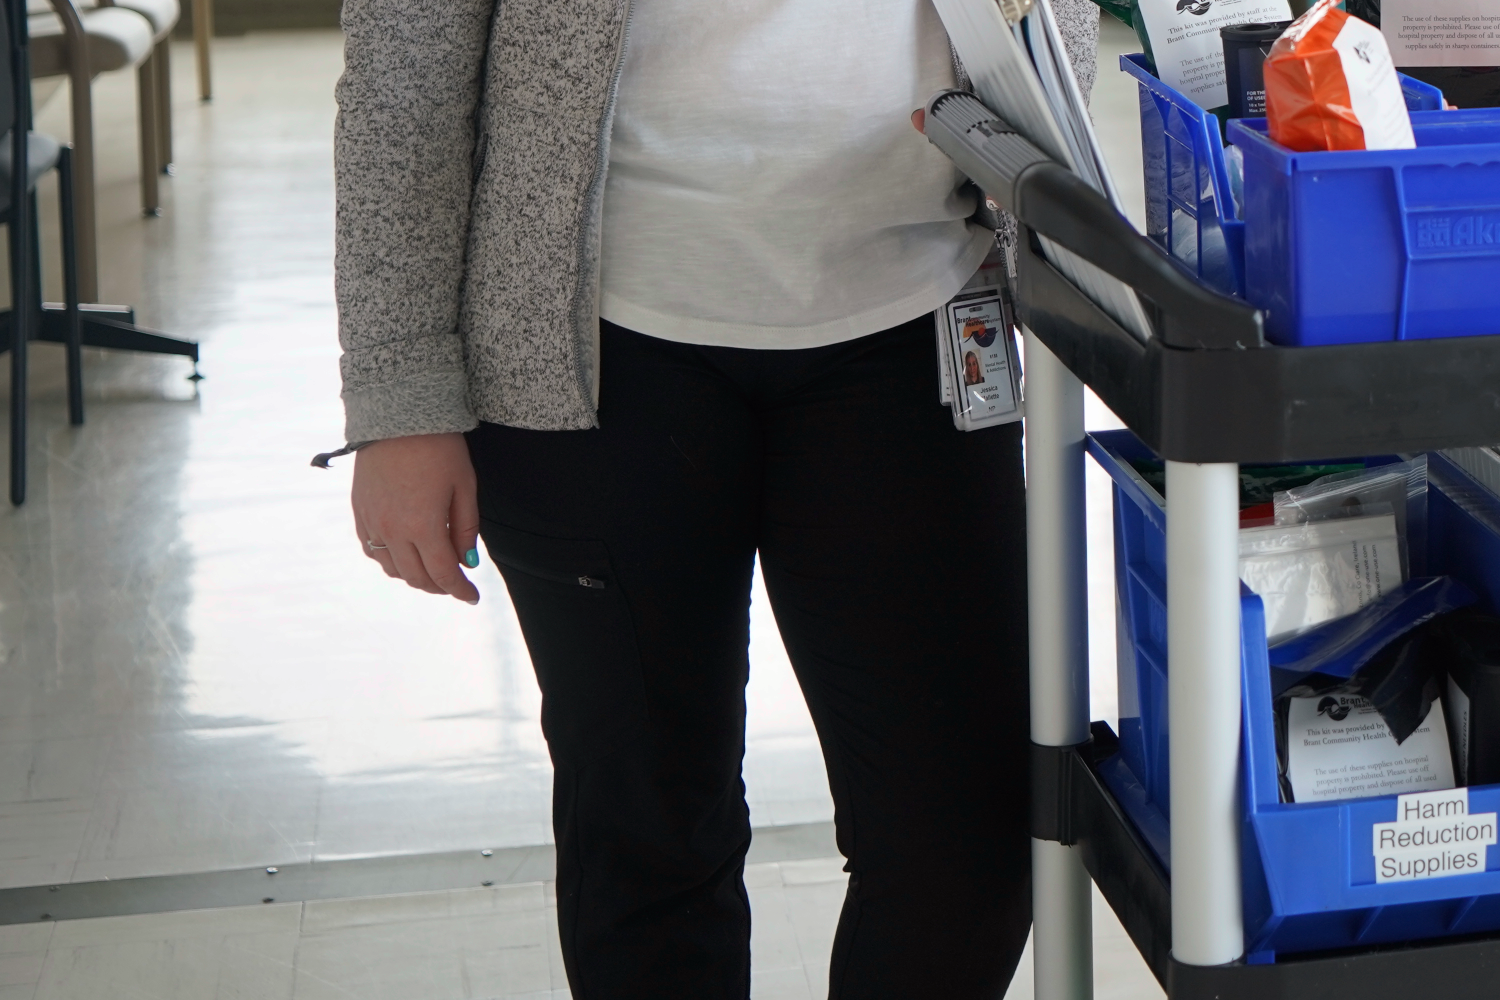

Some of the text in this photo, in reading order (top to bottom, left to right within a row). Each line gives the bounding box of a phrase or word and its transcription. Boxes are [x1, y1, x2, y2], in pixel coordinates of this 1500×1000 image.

[1449, 15, 1471, 23] supplies
[1402, 24, 1426, 32] property
[1398, 32, 1420, 40] hospital
[1457, 32, 1477, 40] dispose
[1322, 727, 1330, 735] kit
[1345, 723, 1375, 734] provided
[1376, 723, 1385, 731] by
[1404, 799, 1464, 821] Harm
[1380, 822, 1492, 849] Reduction
[1381, 851, 1478, 878] Supplies
